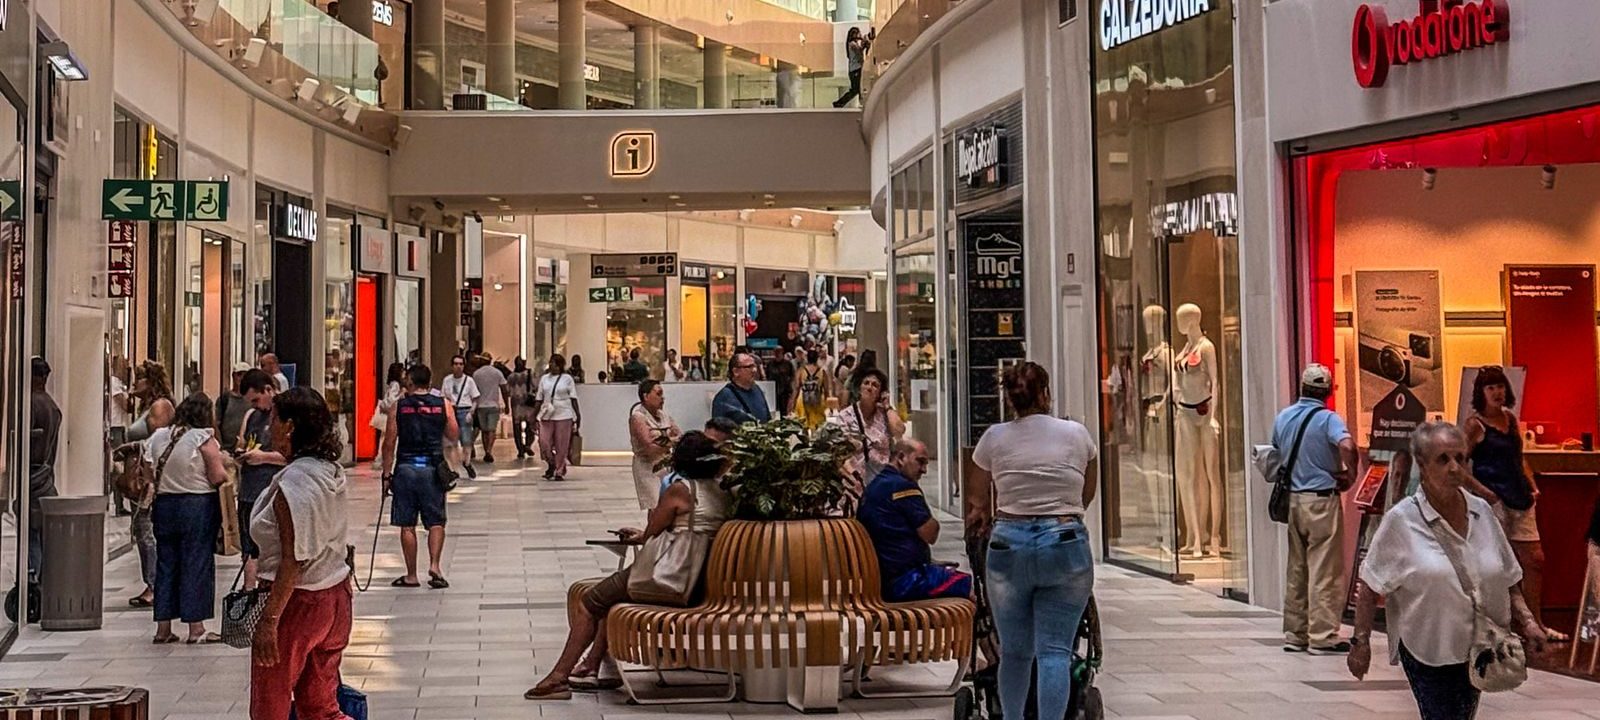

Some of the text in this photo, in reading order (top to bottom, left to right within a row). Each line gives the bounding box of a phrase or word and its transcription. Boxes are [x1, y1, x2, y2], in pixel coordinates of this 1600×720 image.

[1100, 0, 1209, 51] CALZED
[1384, 0, 1509, 65] vodafone
[959, 126, 998, 185] MegaCalzado
